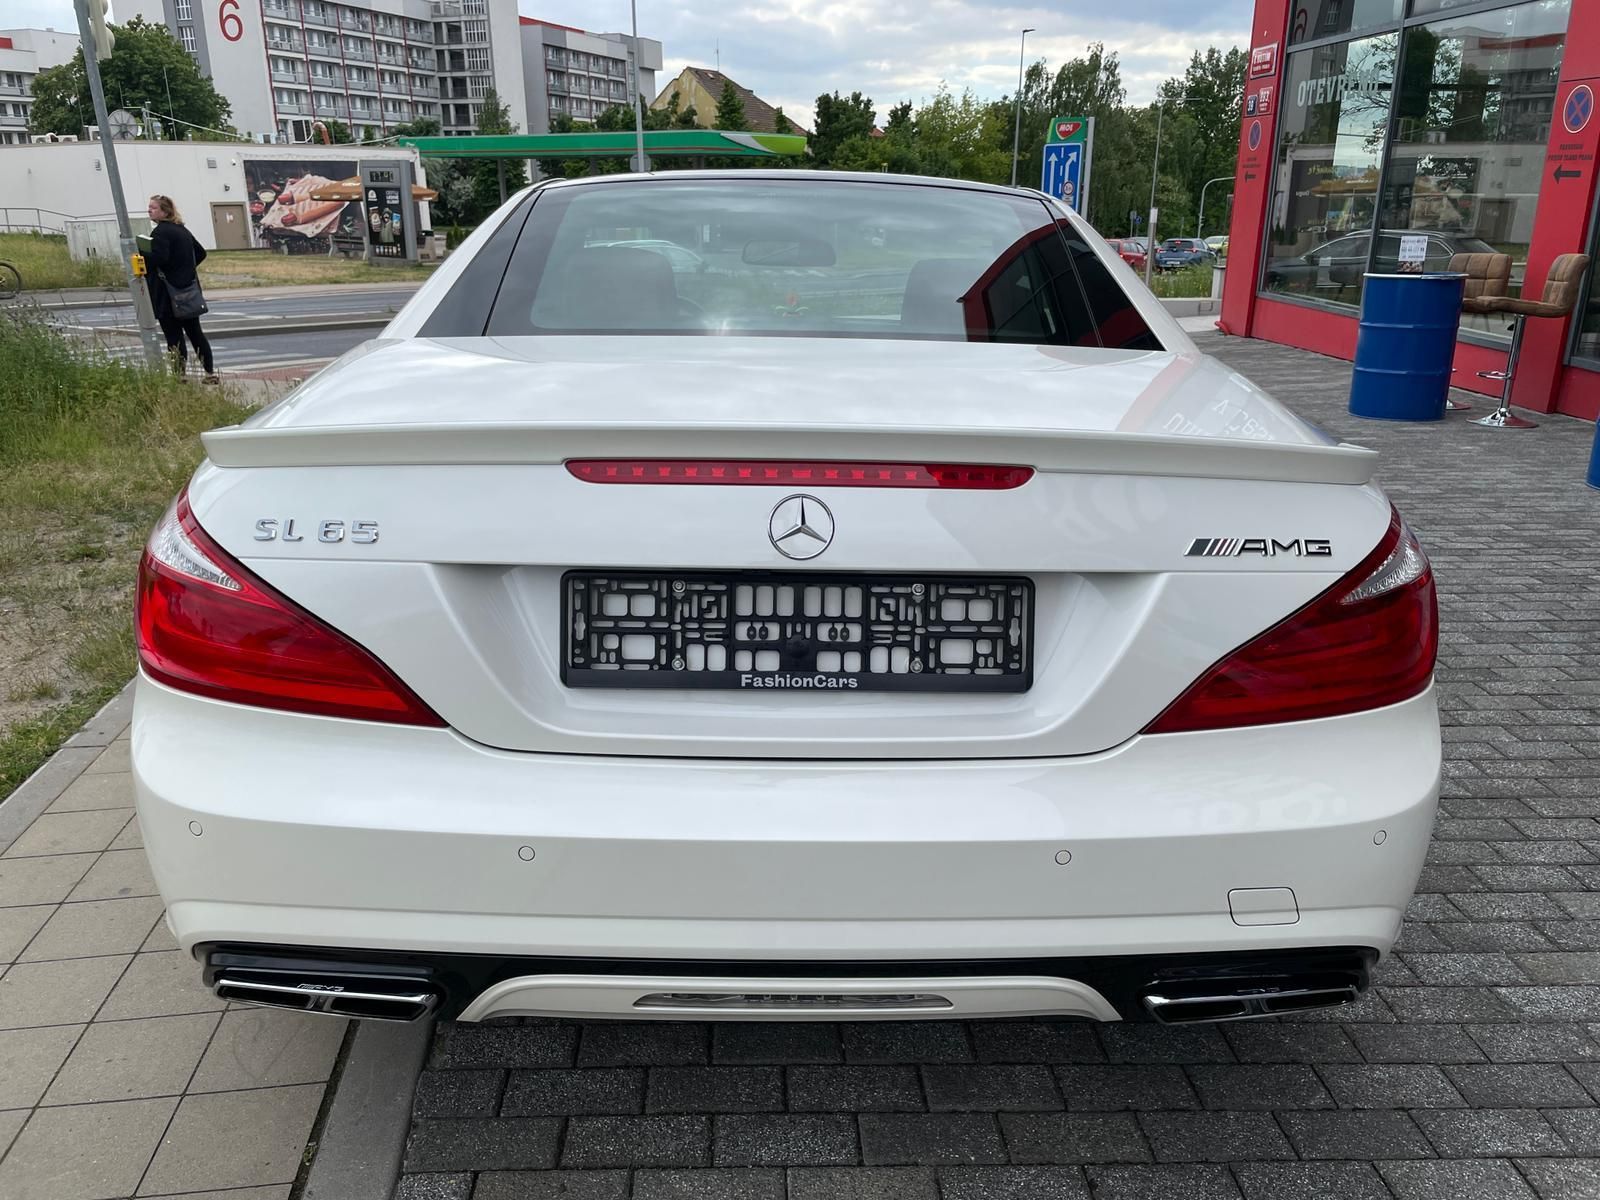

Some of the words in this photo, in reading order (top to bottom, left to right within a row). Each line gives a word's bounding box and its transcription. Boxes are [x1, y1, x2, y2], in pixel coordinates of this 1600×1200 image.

[219, 0, 243, 42] 6
[1058, 123, 1074, 132] MOL
[253, 519, 304, 542] SL
[318, 519, 379, 544] 65
[1232, 538, 1332, 557] AMG
[741, 674, 858, 688] FashionCars
